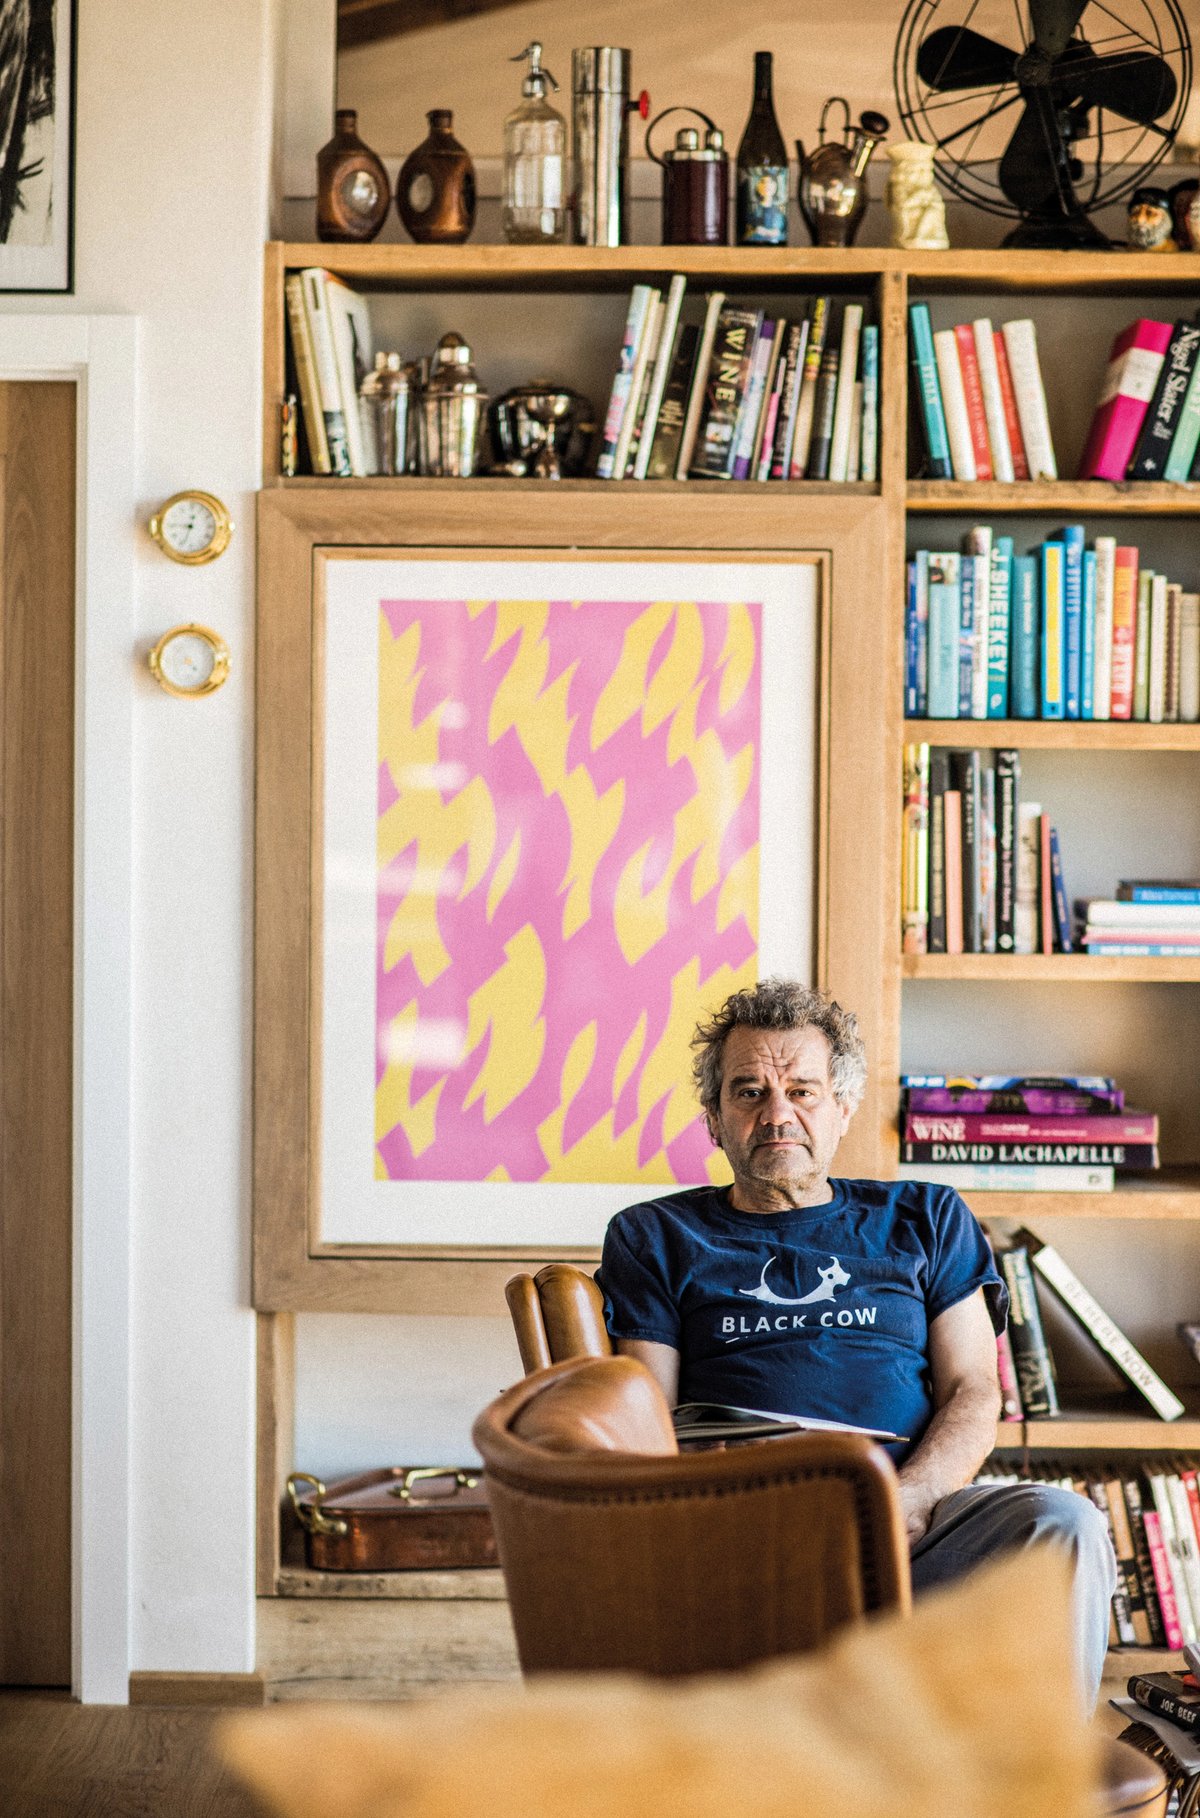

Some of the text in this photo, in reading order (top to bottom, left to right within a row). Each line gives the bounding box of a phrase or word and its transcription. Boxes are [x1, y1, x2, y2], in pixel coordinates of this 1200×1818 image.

[1169, 324, 1200, 374] Nigel
[715, 328, 747, 403] WINE
[1157, 371, 1188, 424] Slater
[912, 1120, 966, 1141] WINE
[931, 1144, 1126, 1164] DAVID LACHAPELLE
[722, 1307, 878, 1334] BLACK COW
[1159, 1698, 1198, 1724] JOE BEEF
